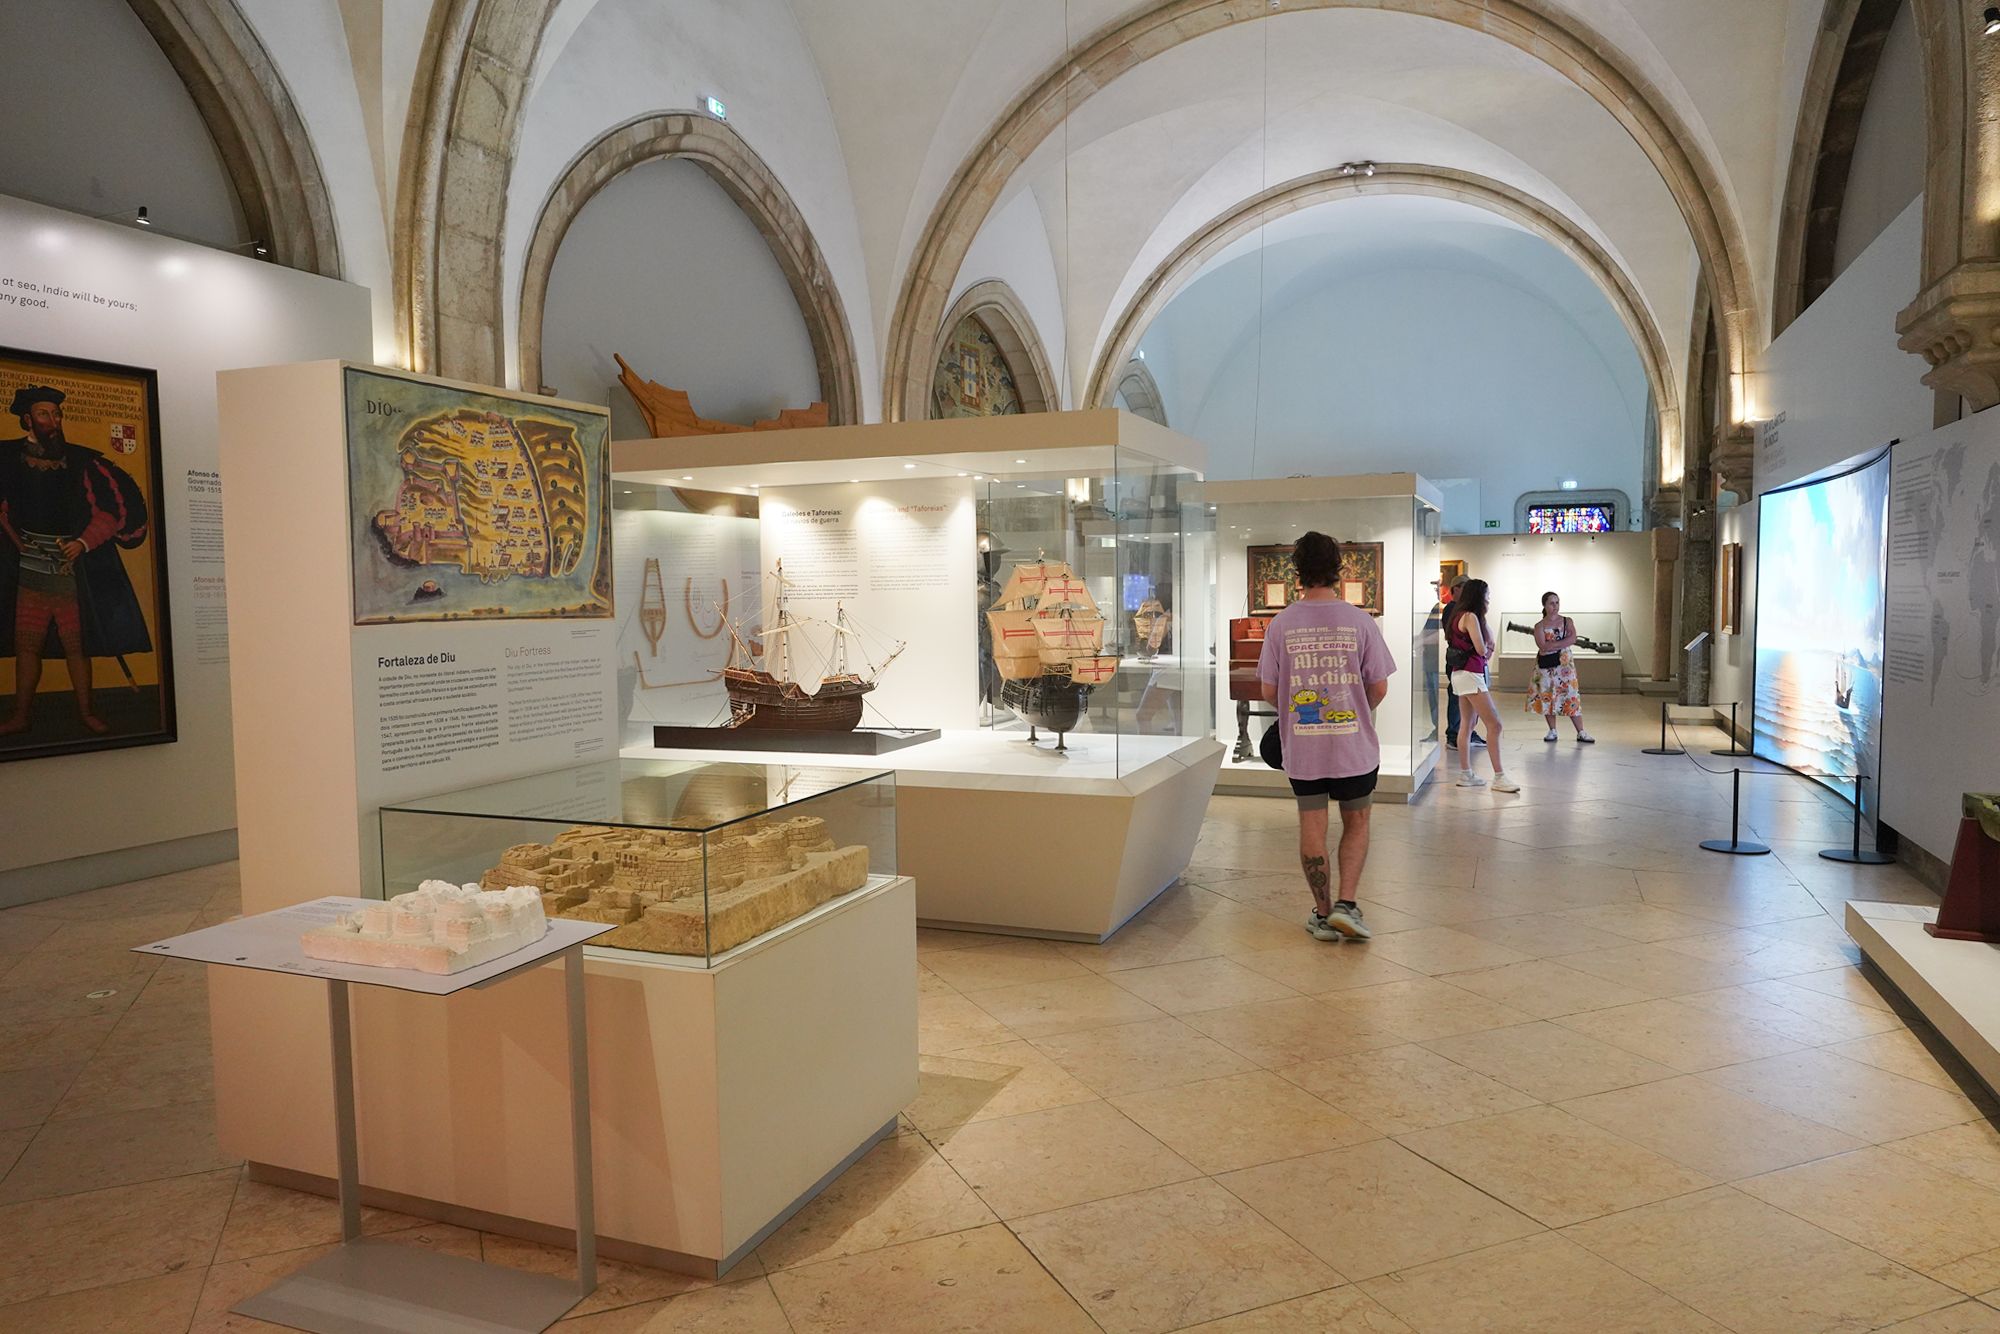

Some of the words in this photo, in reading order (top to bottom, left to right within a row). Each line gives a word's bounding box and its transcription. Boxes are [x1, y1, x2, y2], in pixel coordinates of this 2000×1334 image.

[0, 292, 18, 305] any
[20, 297, 49, 309] good.
[2, 277, 14, 287] at
[42, 284, 70, 298] India
[72, 291, 91, 302] will
[93, 294, 106, 305] be
[107, 298, 138, 312] yours;
[187, 469, 210, 478] Afonso
[812, 509, 842, 517] Taforeias:
[819, 518, 840, 526] guerra
[505, 648, 518, 658] Diu
[520, 646, 552, 656] Fortress
[1288, 644, 1320, 652] SPACE
[1322, 642, 1356, 650] CRANE
[378, 654, 425, 668] Fortaleza
[426, 654, 439, 664] de
[440, 652, 456, 663] Diu
[1294, 652, 1348, 670] Aliens
[1308, 669, 1358, 686] action
